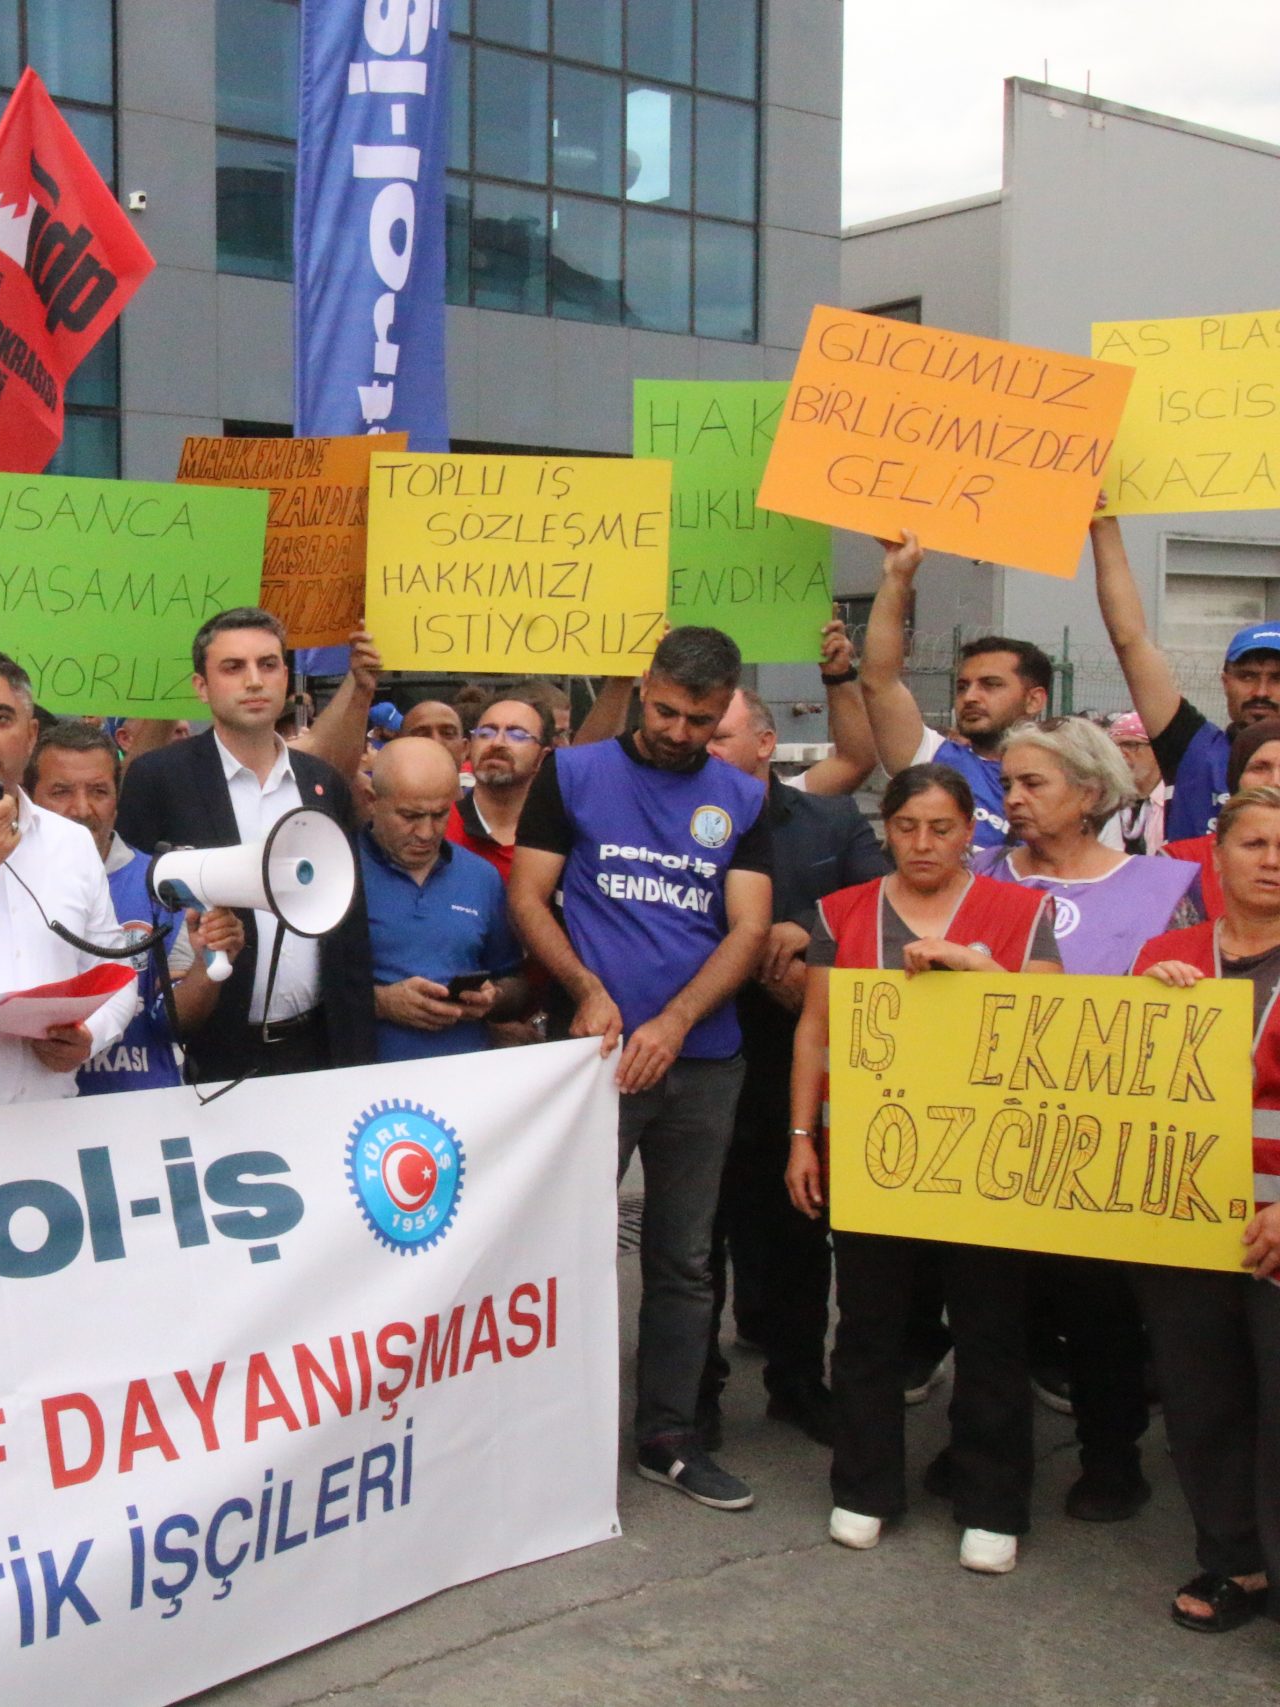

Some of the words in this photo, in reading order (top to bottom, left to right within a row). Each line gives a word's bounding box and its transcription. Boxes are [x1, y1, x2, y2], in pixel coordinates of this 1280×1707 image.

[819, 322, 1095, 410] GÜCÜMÜZ
[1097, 323, 1171, 359] AS
[1200, 318, 1280, 351] PLA
[650, 398, 785, 457] HAK
[375, 462, 506, 498] TOPLU
[536, 460, 575, 500] İŞ
[826, 454, 995, 523] GELİR
[426, 504, 663, 550] SÖZLEŞME
[383, 561, 593, 602] HAKKIMIZI
[414, 606, 664, 657] İSTİYORUZ
[849, 981, 901, 1081] İŞ
[969, 993, 1223, 1102] EKMEK
[391, 1203, 439, 1232] 1952
[41, 1276, 558, 1491] DAYANIŞMASI
[127, 1416, 415, 1620] İŞÇİLERİ
